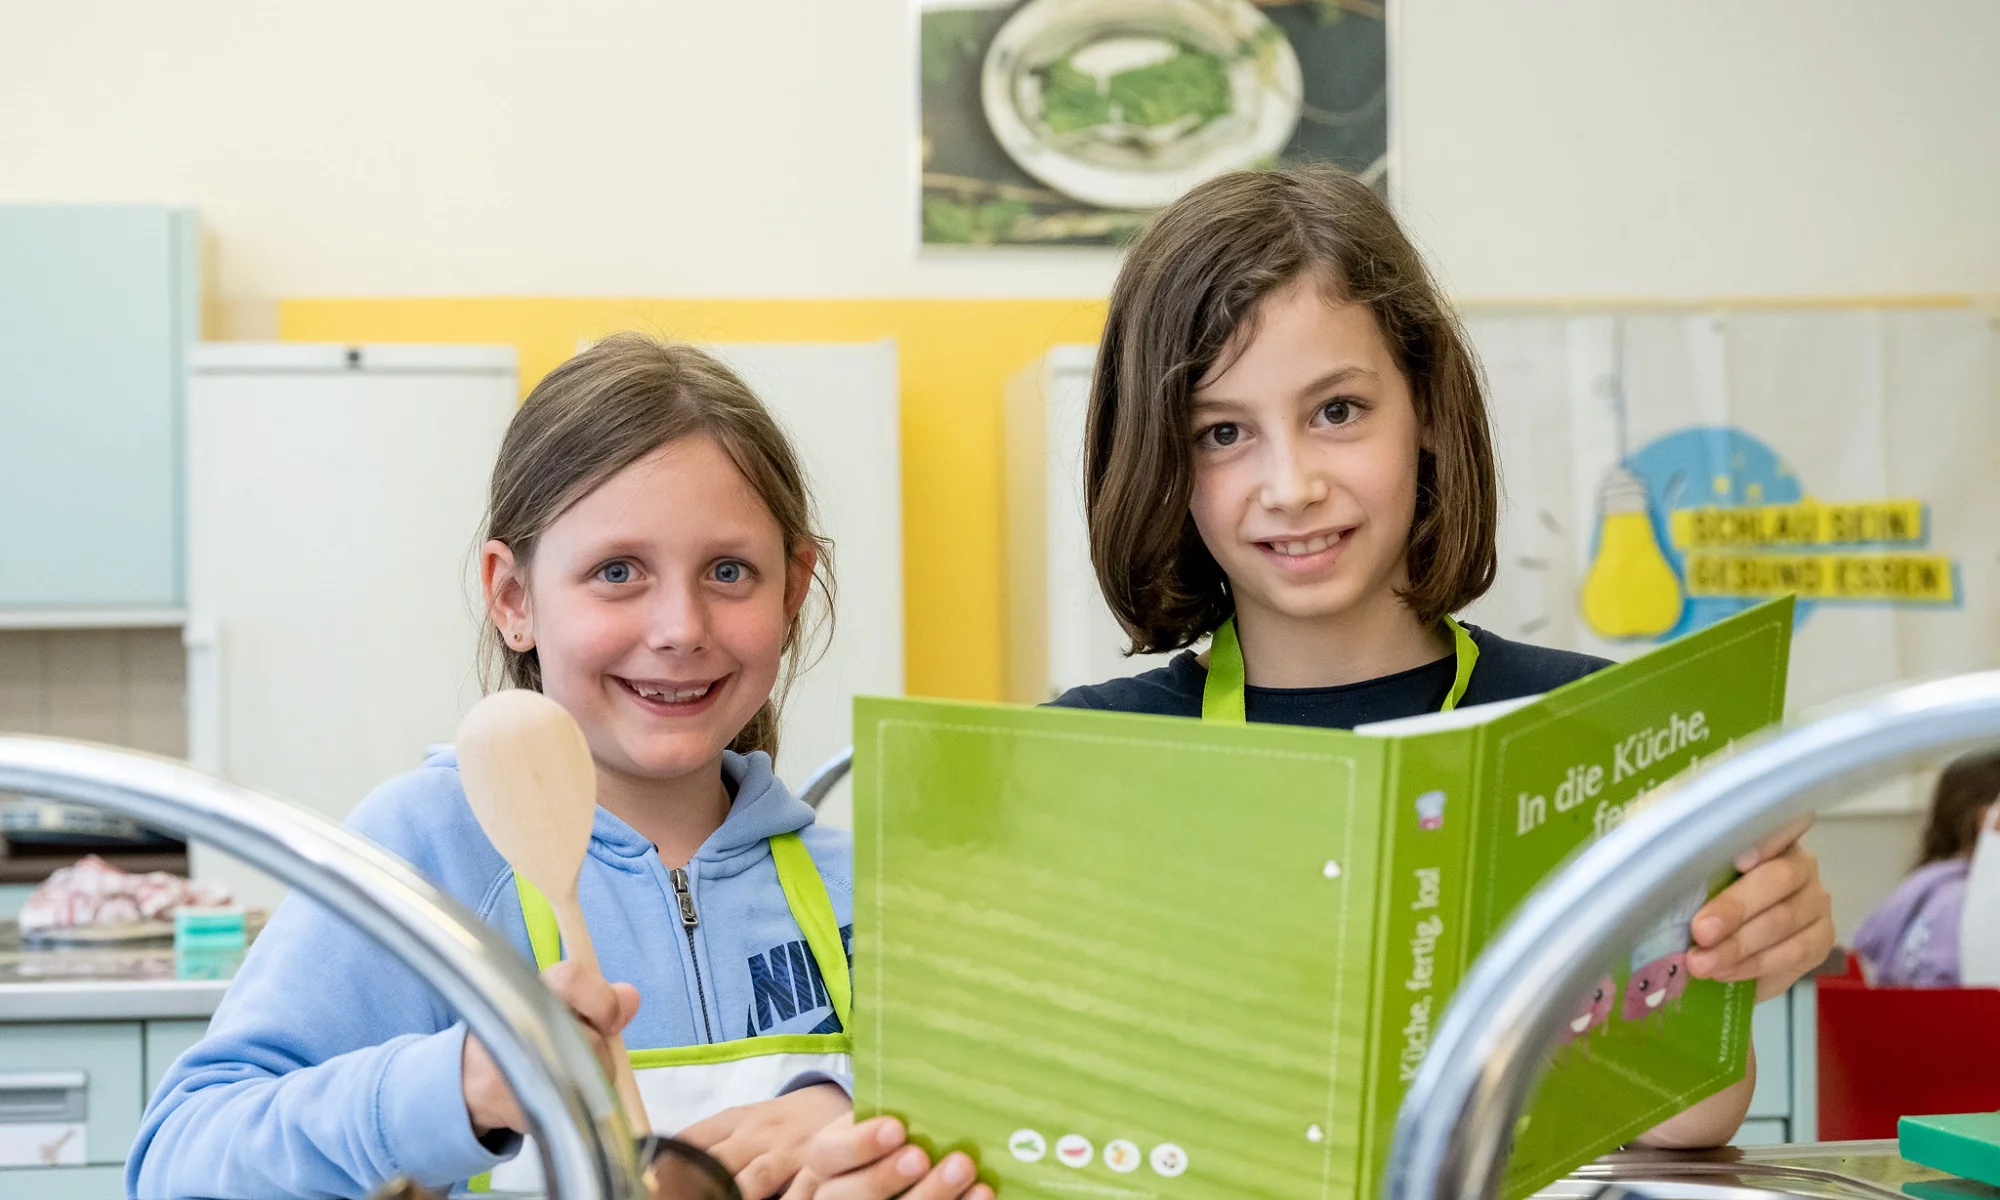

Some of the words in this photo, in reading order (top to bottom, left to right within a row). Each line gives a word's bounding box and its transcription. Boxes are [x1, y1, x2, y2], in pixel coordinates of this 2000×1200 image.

[1693, 507, 1818, 545] SCHLAU
[1831, 505, 1909, 541] SEIN
[1694, 555, 1824, 591] GESUND
[1834, 557, 1941, 594] ESSEN
[1516, 790, 1547, 837] In
[1554, 764, 1604, 813] die
[1612, 710, 1710, 784] Küche,
